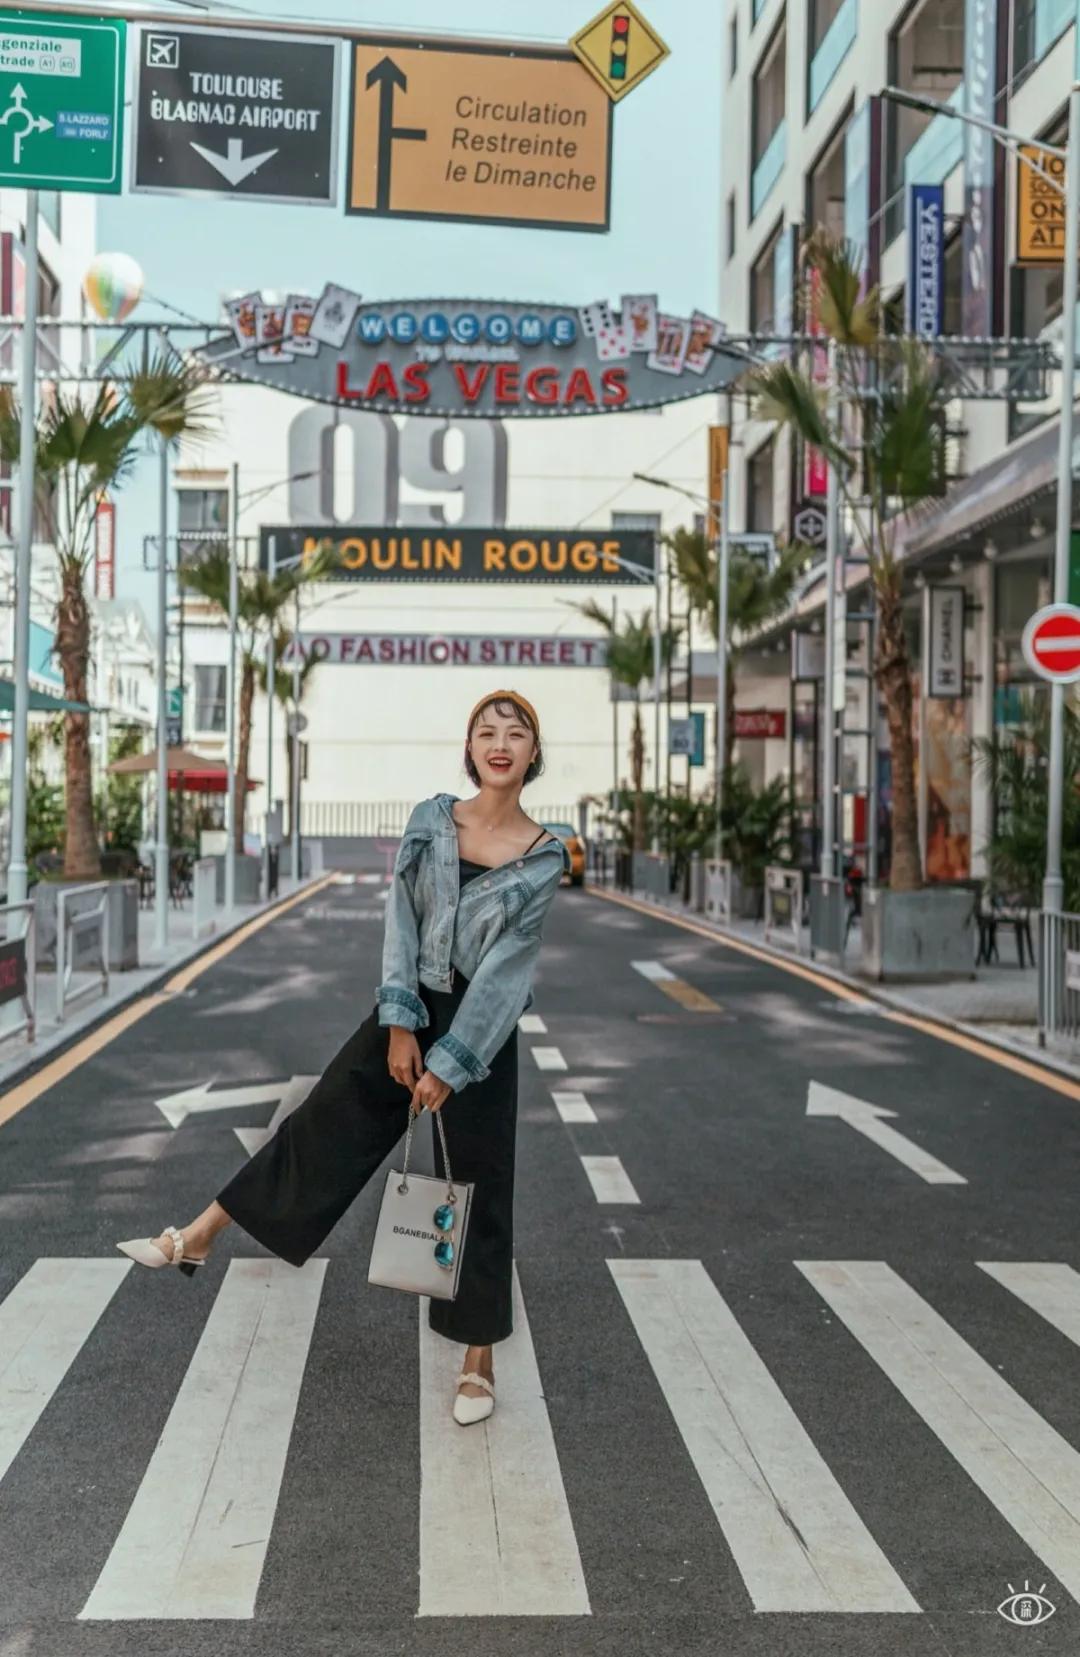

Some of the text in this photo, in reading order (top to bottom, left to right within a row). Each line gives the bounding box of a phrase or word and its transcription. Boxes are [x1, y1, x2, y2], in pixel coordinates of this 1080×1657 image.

[189, 72, 283, 100] TOULOUSE
[151, 98, 321, 132] BLAGNAC AIRPORT
[455, 96, 587, 126] Circulation
[451, 128, 578, 158] Restreinte
[445, 160, 596, 192] le Dimanche
[359, 316, 572, 340] WELCOME
[336, 362, 630, 406] LAS VEGAS
[288, 404, 508, 527] 09
[484, 540, 621, 573] ROUGE
[340, 637, 470, 664] FASHION
[480, 640, 595, 664] STREET
